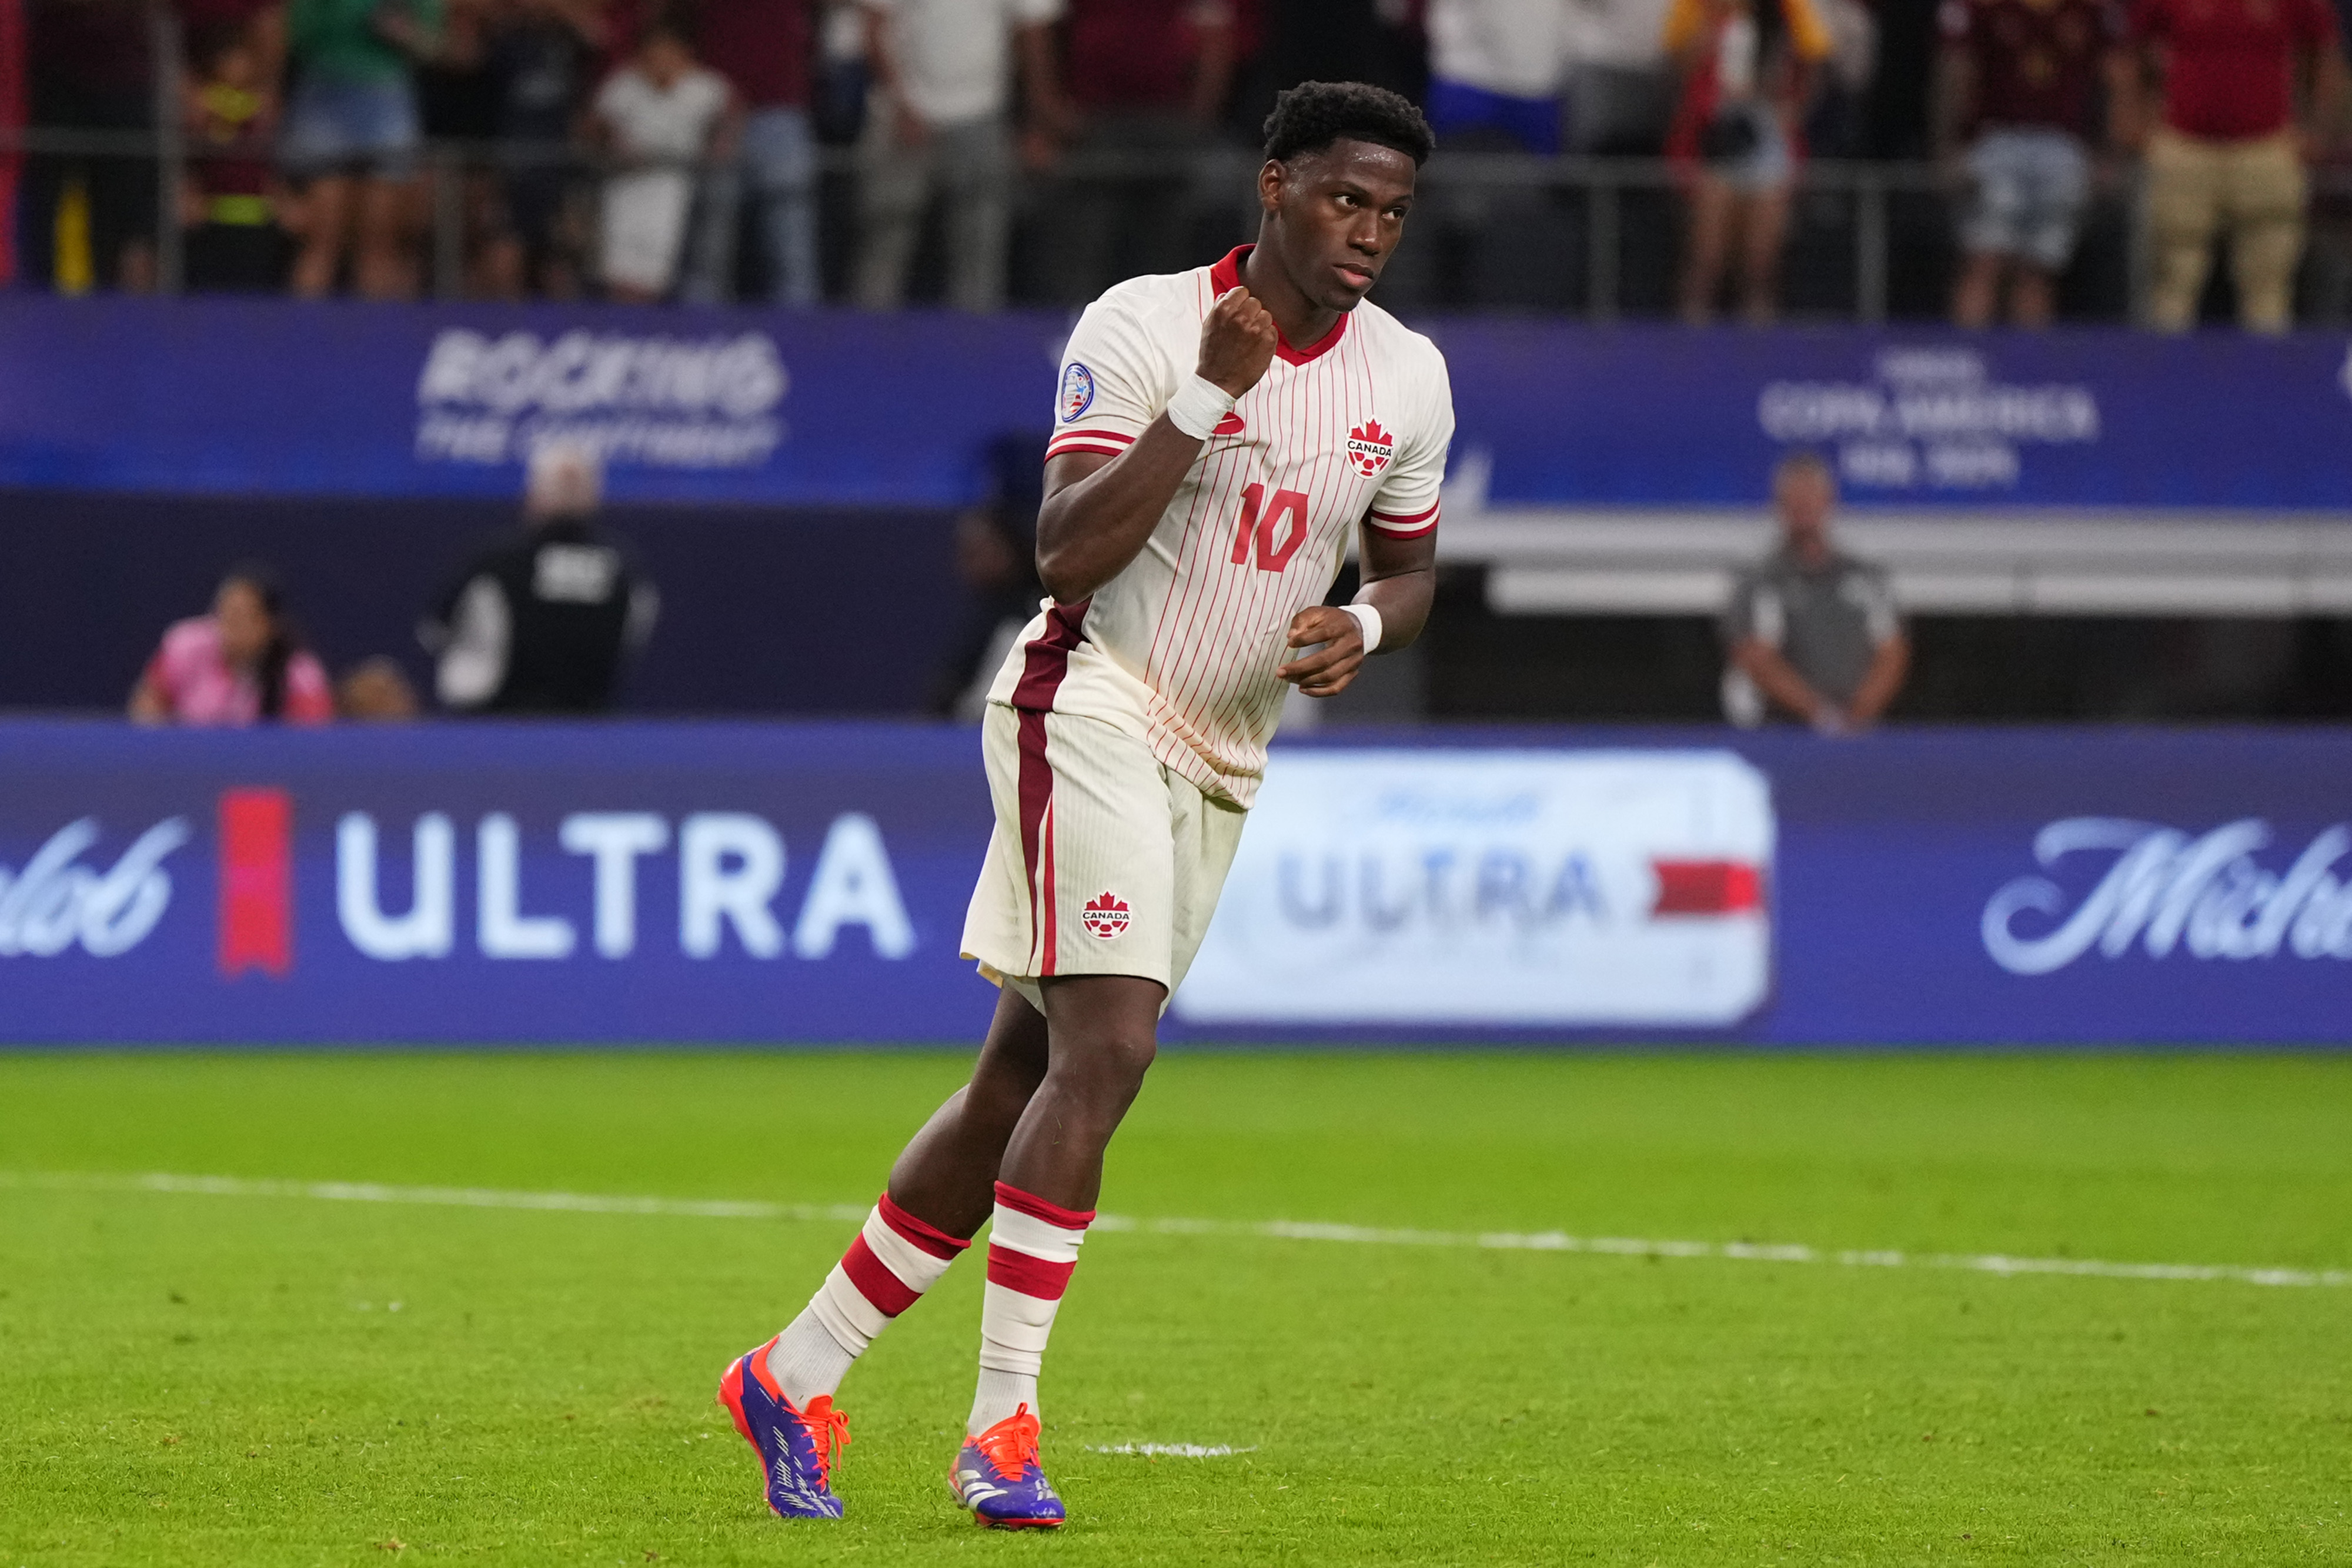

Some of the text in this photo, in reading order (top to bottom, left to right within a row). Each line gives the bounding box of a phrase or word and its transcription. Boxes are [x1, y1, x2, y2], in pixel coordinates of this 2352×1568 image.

[415, 328, 787, 414] ROCKING
[1348, 440, 1392, 456] CANADA
[1231, 483, 1309, 572] 10
[336, 811, 916, 960] ULTRA
[1275, 847, 1614, 929] ULTRA
